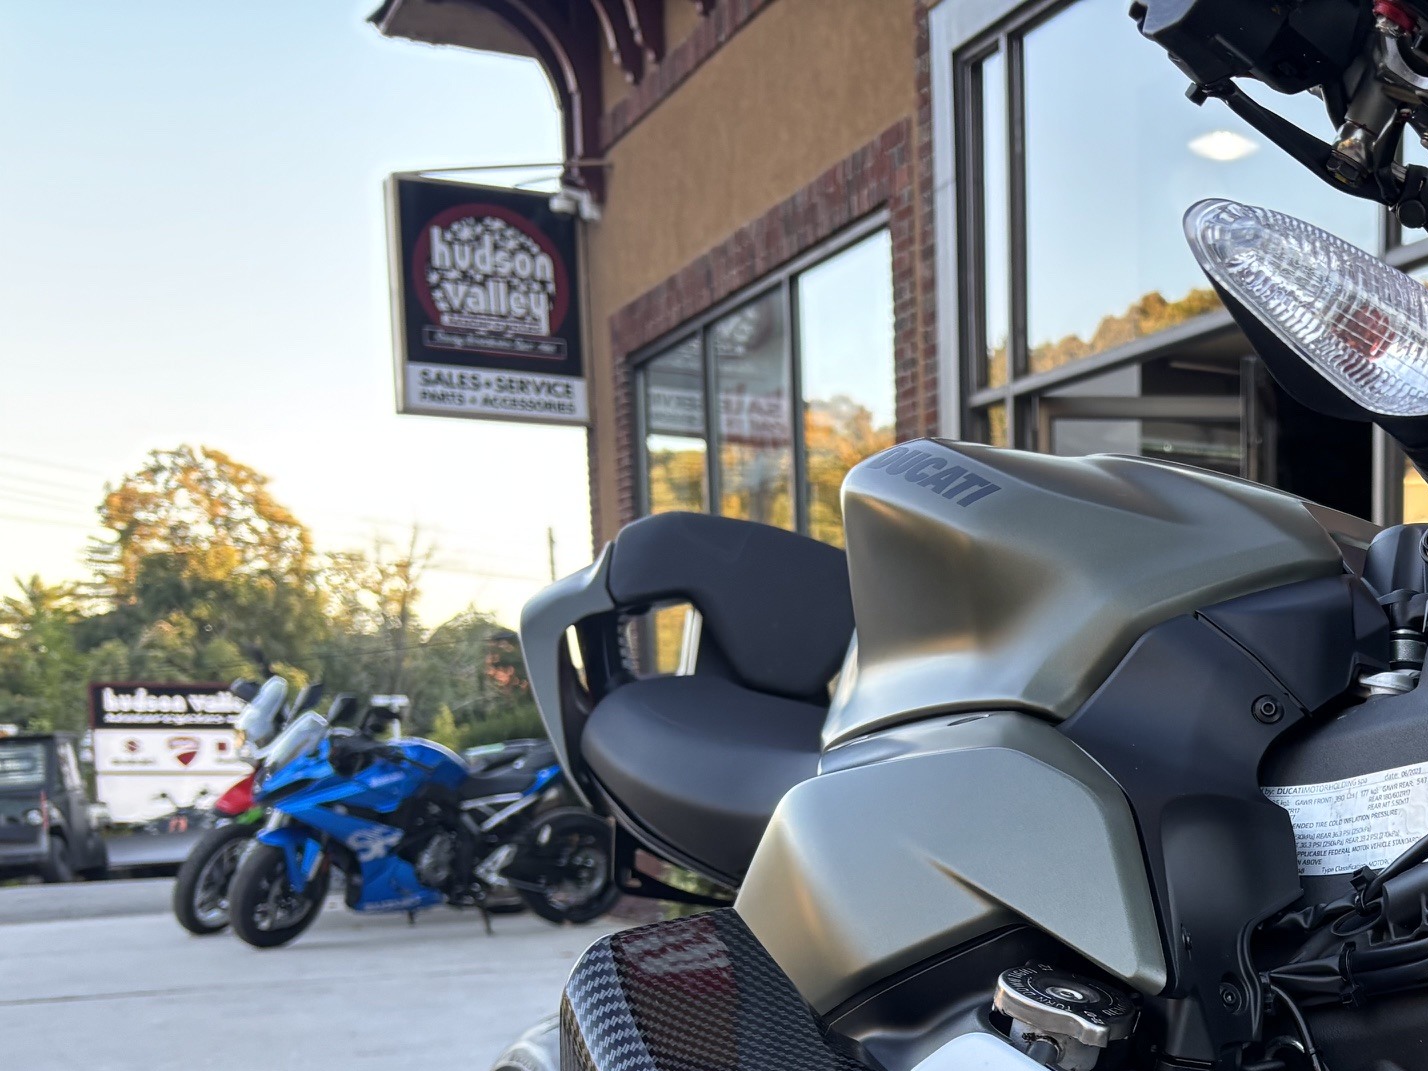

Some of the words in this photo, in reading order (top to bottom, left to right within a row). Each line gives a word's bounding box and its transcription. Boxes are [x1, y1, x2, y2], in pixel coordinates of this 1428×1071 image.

[429, 225, 553, 283] hudson
[442, 278, 551, 336] valley
[418, 368, 481, 391] SALES
[494, 377, 573, 398] SERVICE
[864, 446, 1002, 508] DUCATI
[1297, 848, 1327, 857] PPLICABLE
[1328, 847, 1351, 856] FEDERAL
